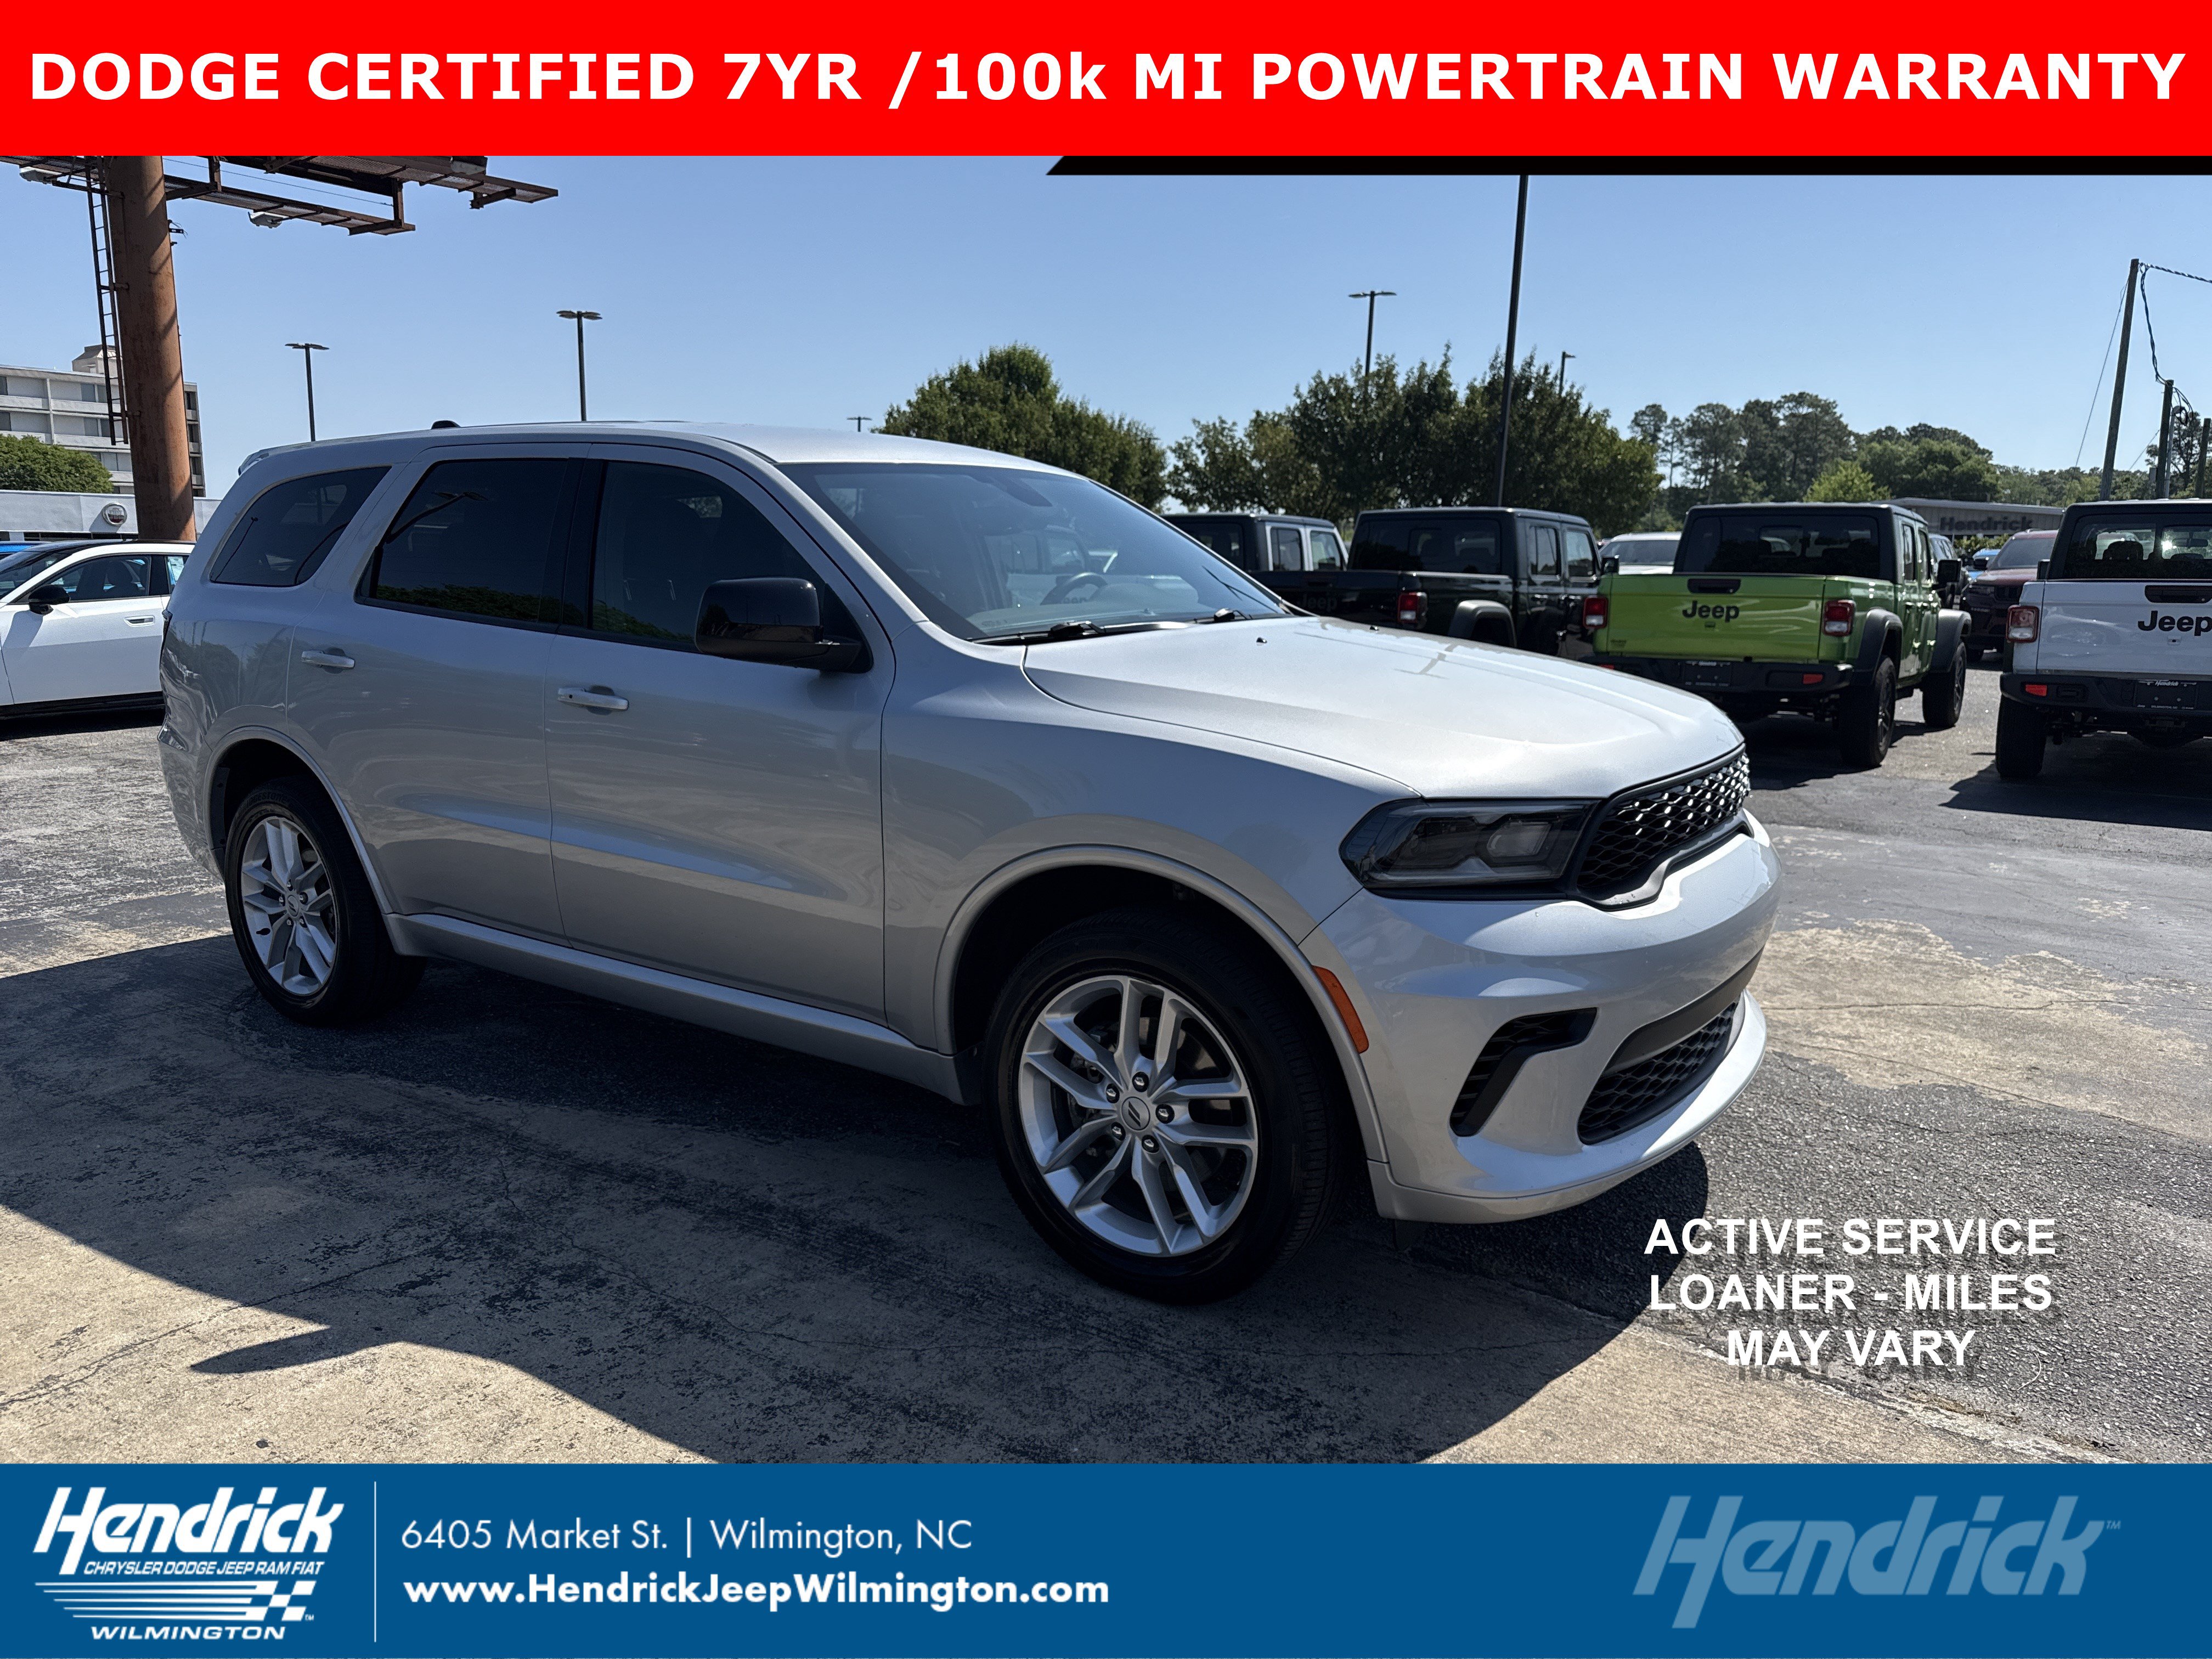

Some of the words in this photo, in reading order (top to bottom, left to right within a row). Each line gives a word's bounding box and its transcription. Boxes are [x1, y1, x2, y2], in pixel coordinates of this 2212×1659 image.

[1940, 516, 2033, 531] Hendrick
[1682, 600, 1739, 623] Jeep
[2138, 610, 2212, 636] Jeep
